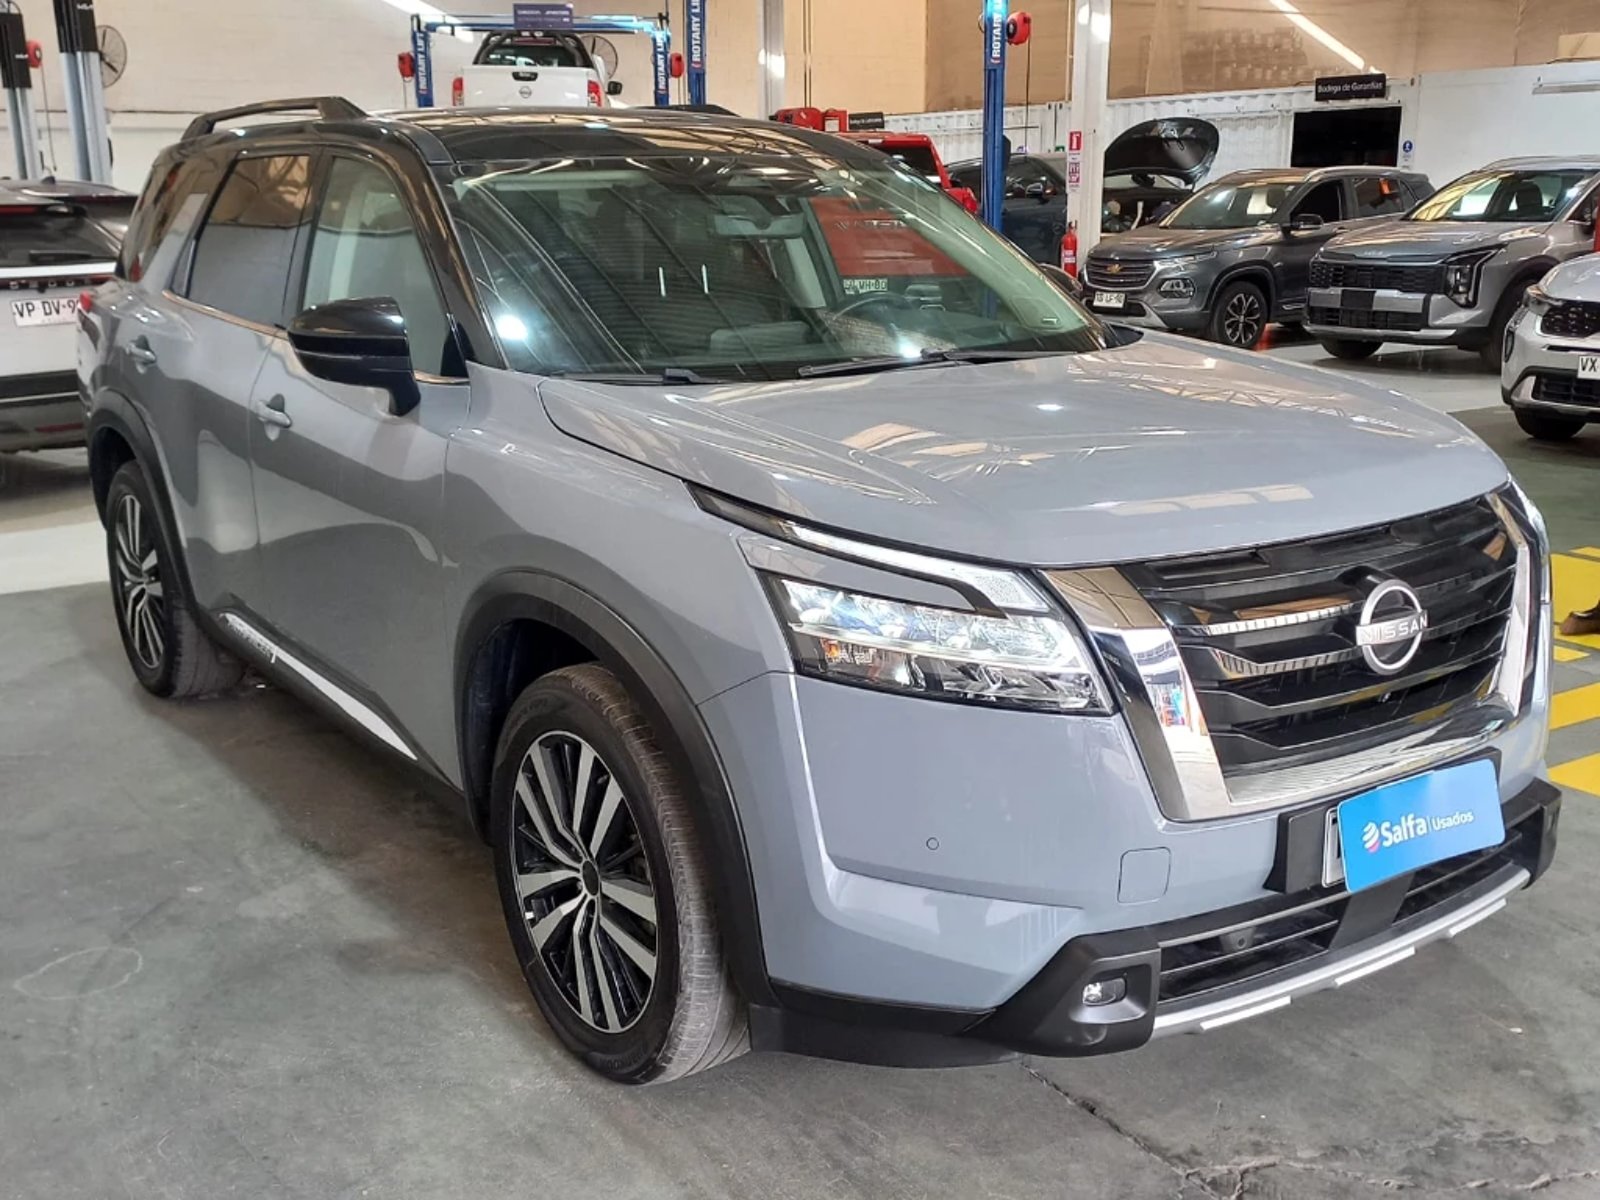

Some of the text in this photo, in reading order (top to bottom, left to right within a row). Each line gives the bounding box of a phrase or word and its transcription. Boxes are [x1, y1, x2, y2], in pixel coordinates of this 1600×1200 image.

[691, 0, 701, 62] ROTARY LI
[416, 32, 427, 89] ROTARY LIFT
[657, 55, 666, 89] ROTARY
[1318, 84, 1342, 94] Bodega
[1342, 83, 1351, 91] de
[14, 301, 35, 318] VP
[1580, 357, 1598, 372] VX
[1361, 611, 1428, 642] NISSAN
[1380, 811, 1474, 848] Salfa Usados
